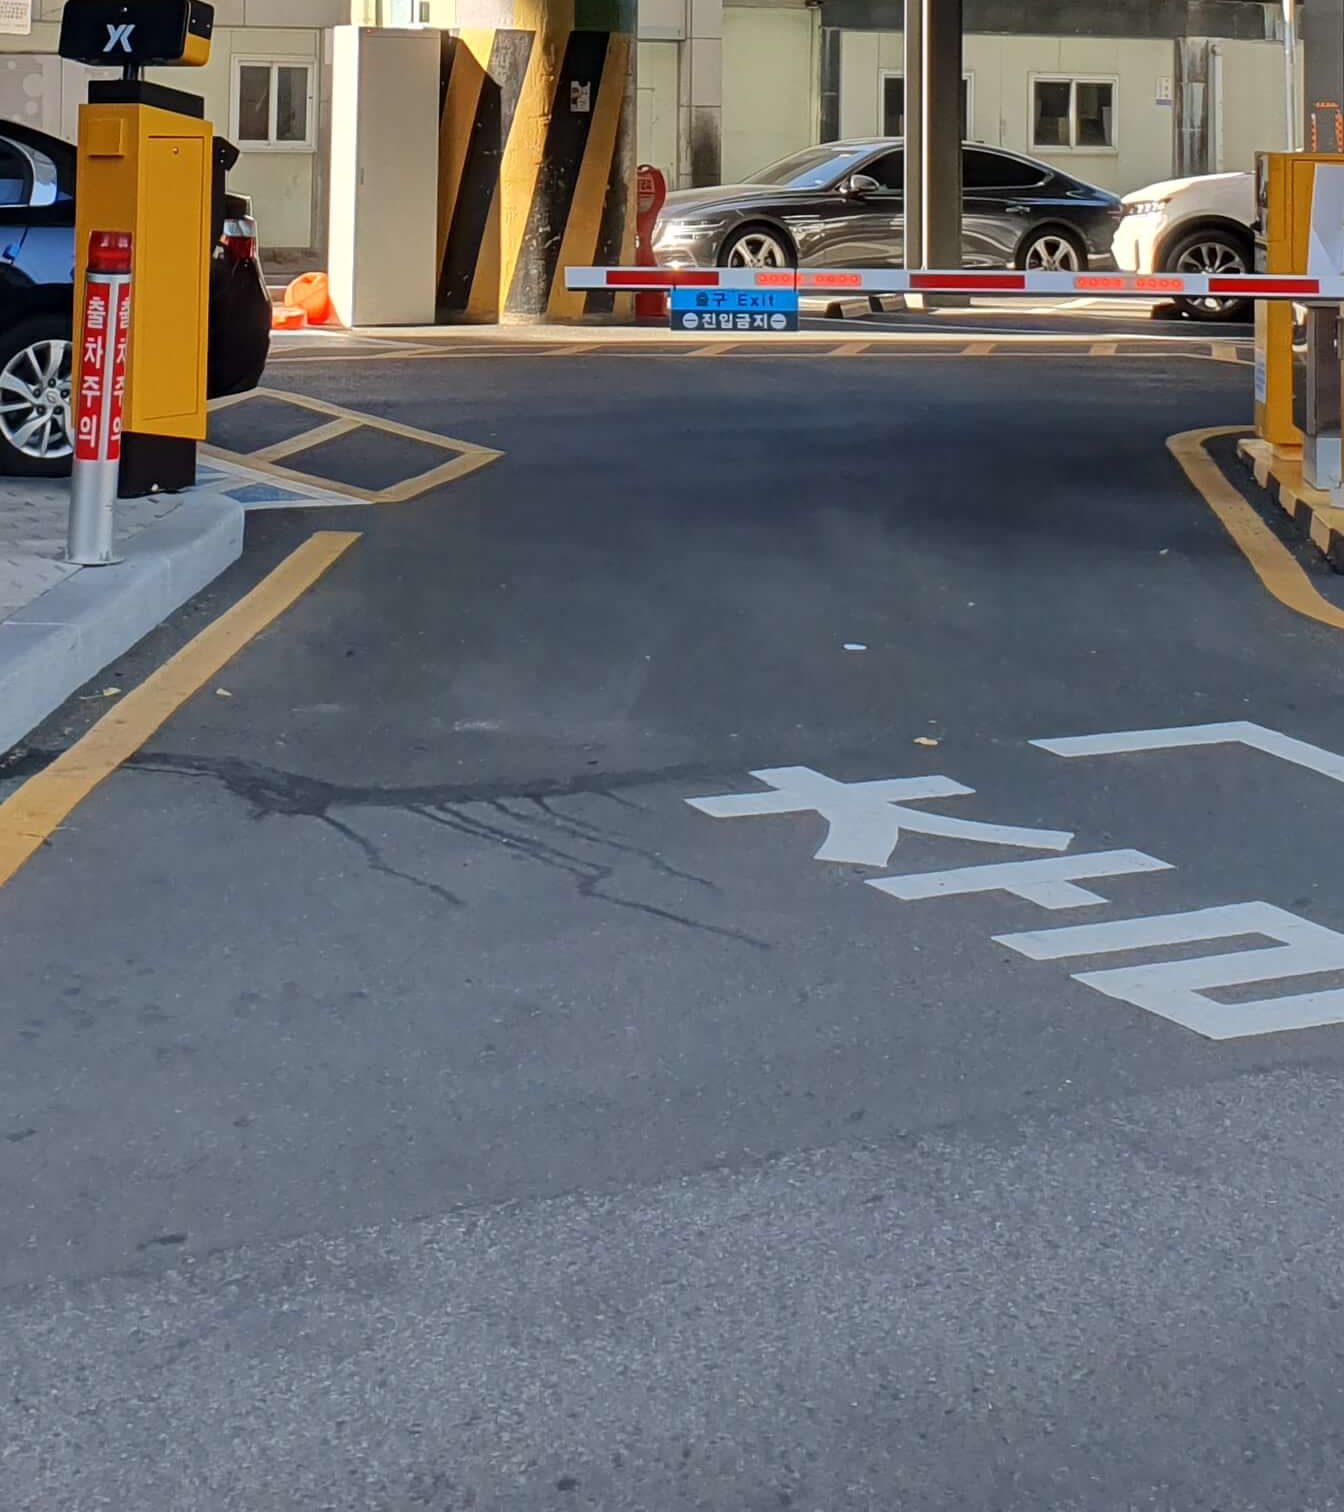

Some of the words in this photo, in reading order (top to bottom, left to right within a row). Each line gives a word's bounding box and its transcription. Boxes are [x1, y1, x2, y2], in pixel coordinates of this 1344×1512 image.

[737, 292, 774, 307] Exit
[701, 312, 769, 329] 진입금지
[78, 296, 107, 448] 출차주의
